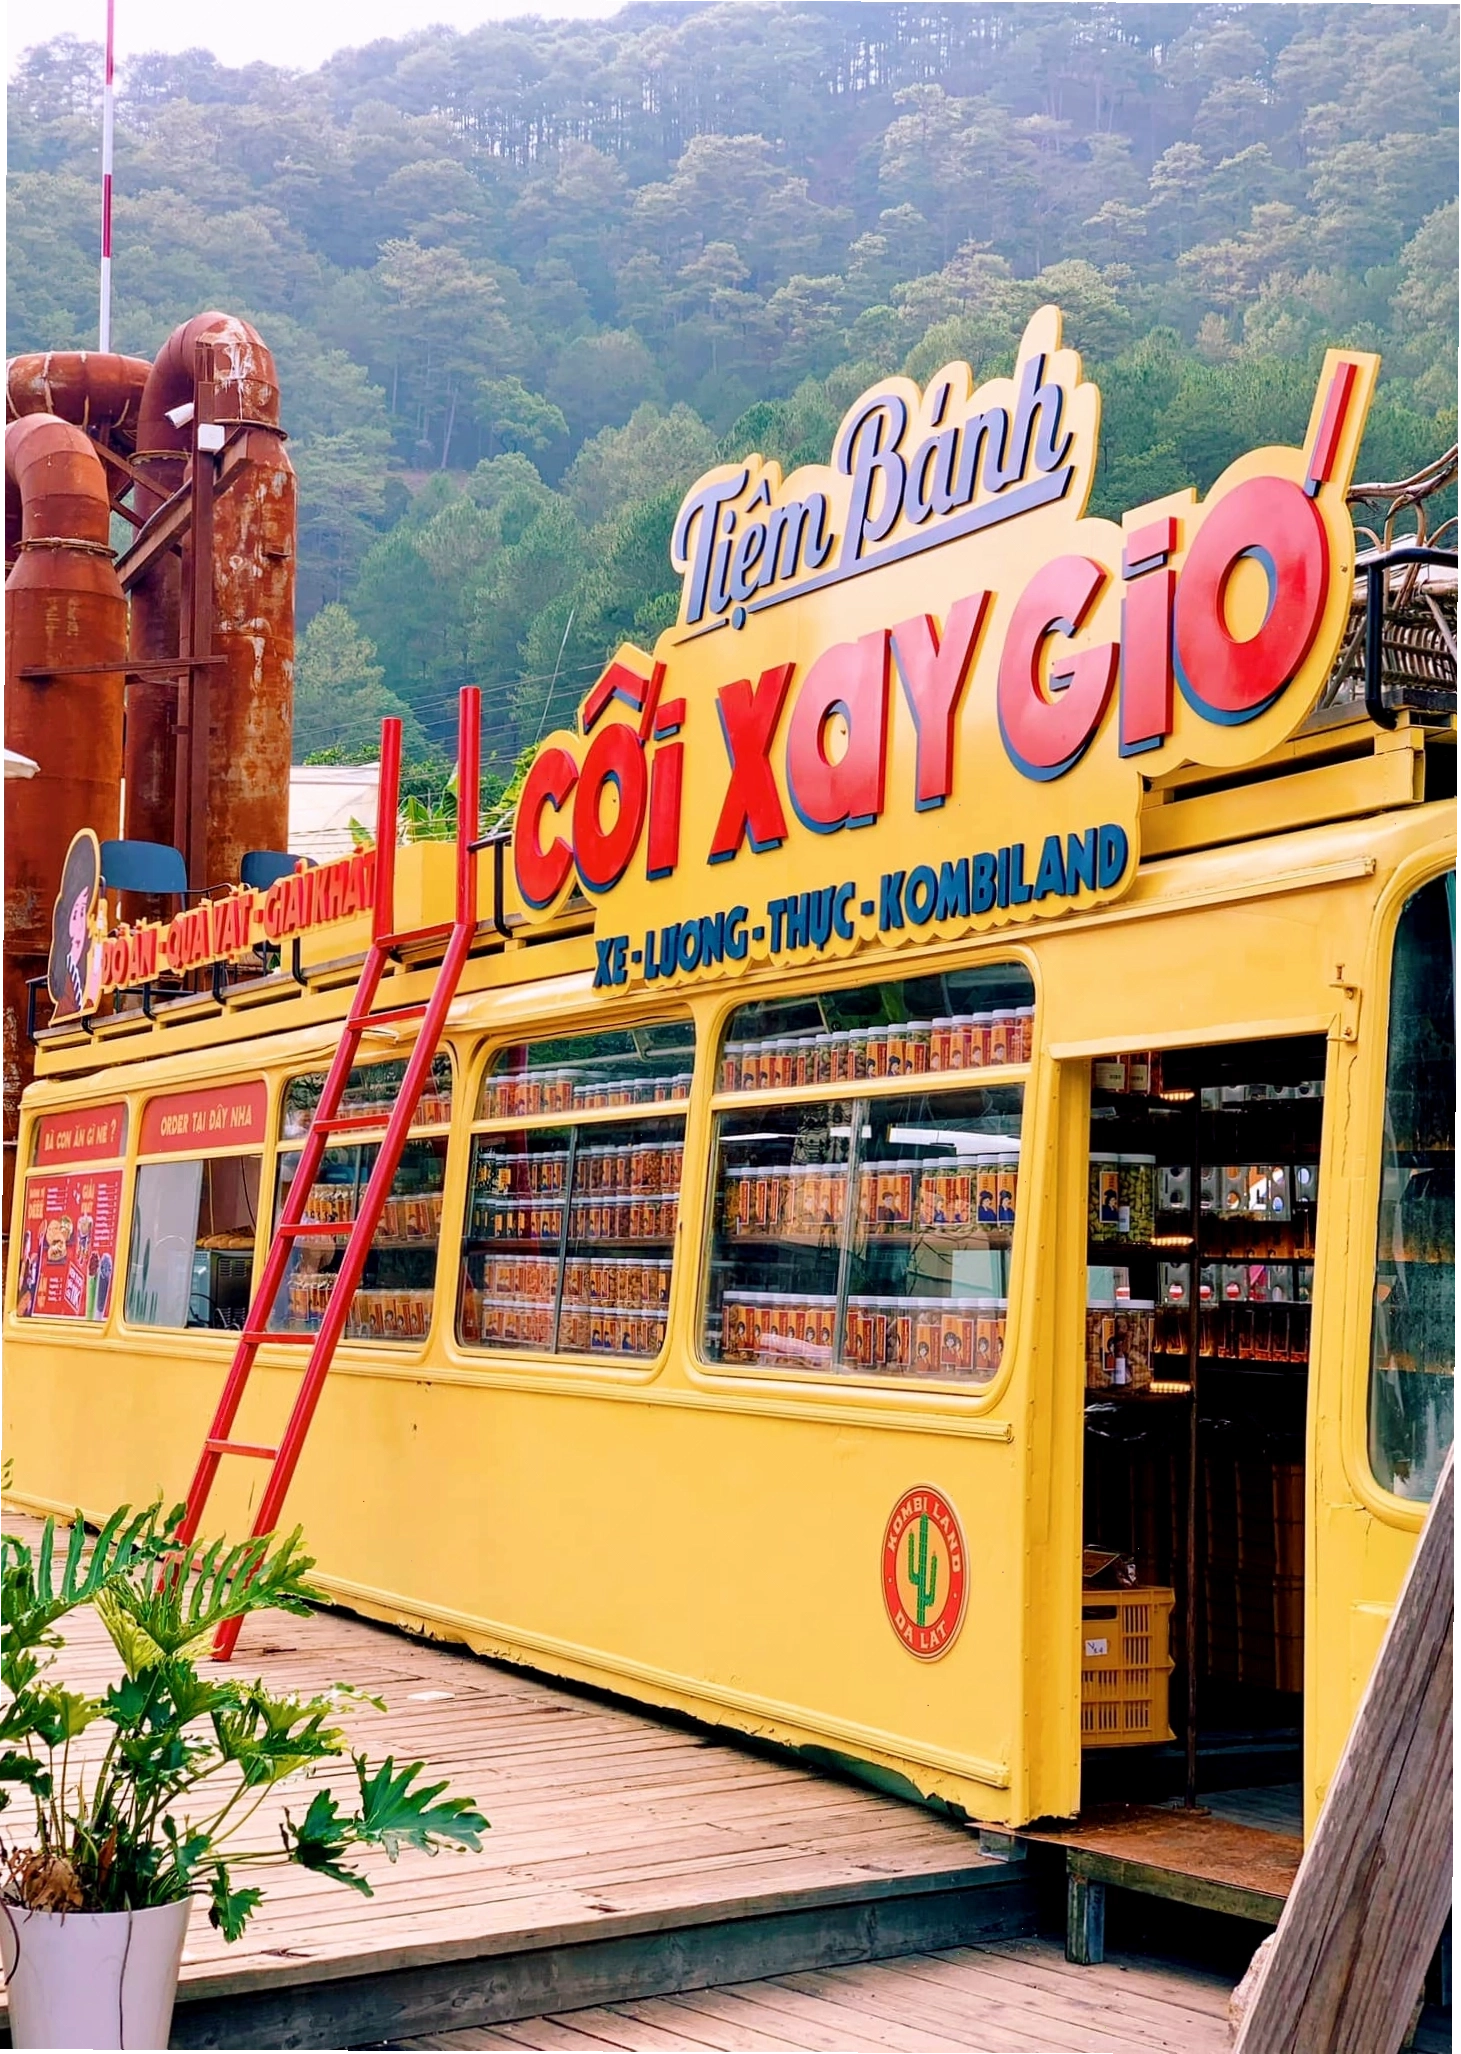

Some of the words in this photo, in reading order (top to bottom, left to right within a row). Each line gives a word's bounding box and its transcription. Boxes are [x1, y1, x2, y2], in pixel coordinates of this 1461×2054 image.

[676, 469, 835, 630] Tiệm
[837, 353, 1074, 560] Bánh
[56, 1130, 72, 1150] CON
[160, 1113, 189, 1137] ORDER
[192, 1111, 207, 1135] TẠI
[209, 1103, 228, 1131] ĐÂY
[230, 1104, 252, 1128] NHA
[887, 1496, 929, 1553] KOMBI
[933, 1502, 961, 1573] LAND
[894, 1609, 914, 1644] DA
[920, 1620, 948, 1649] LAT
